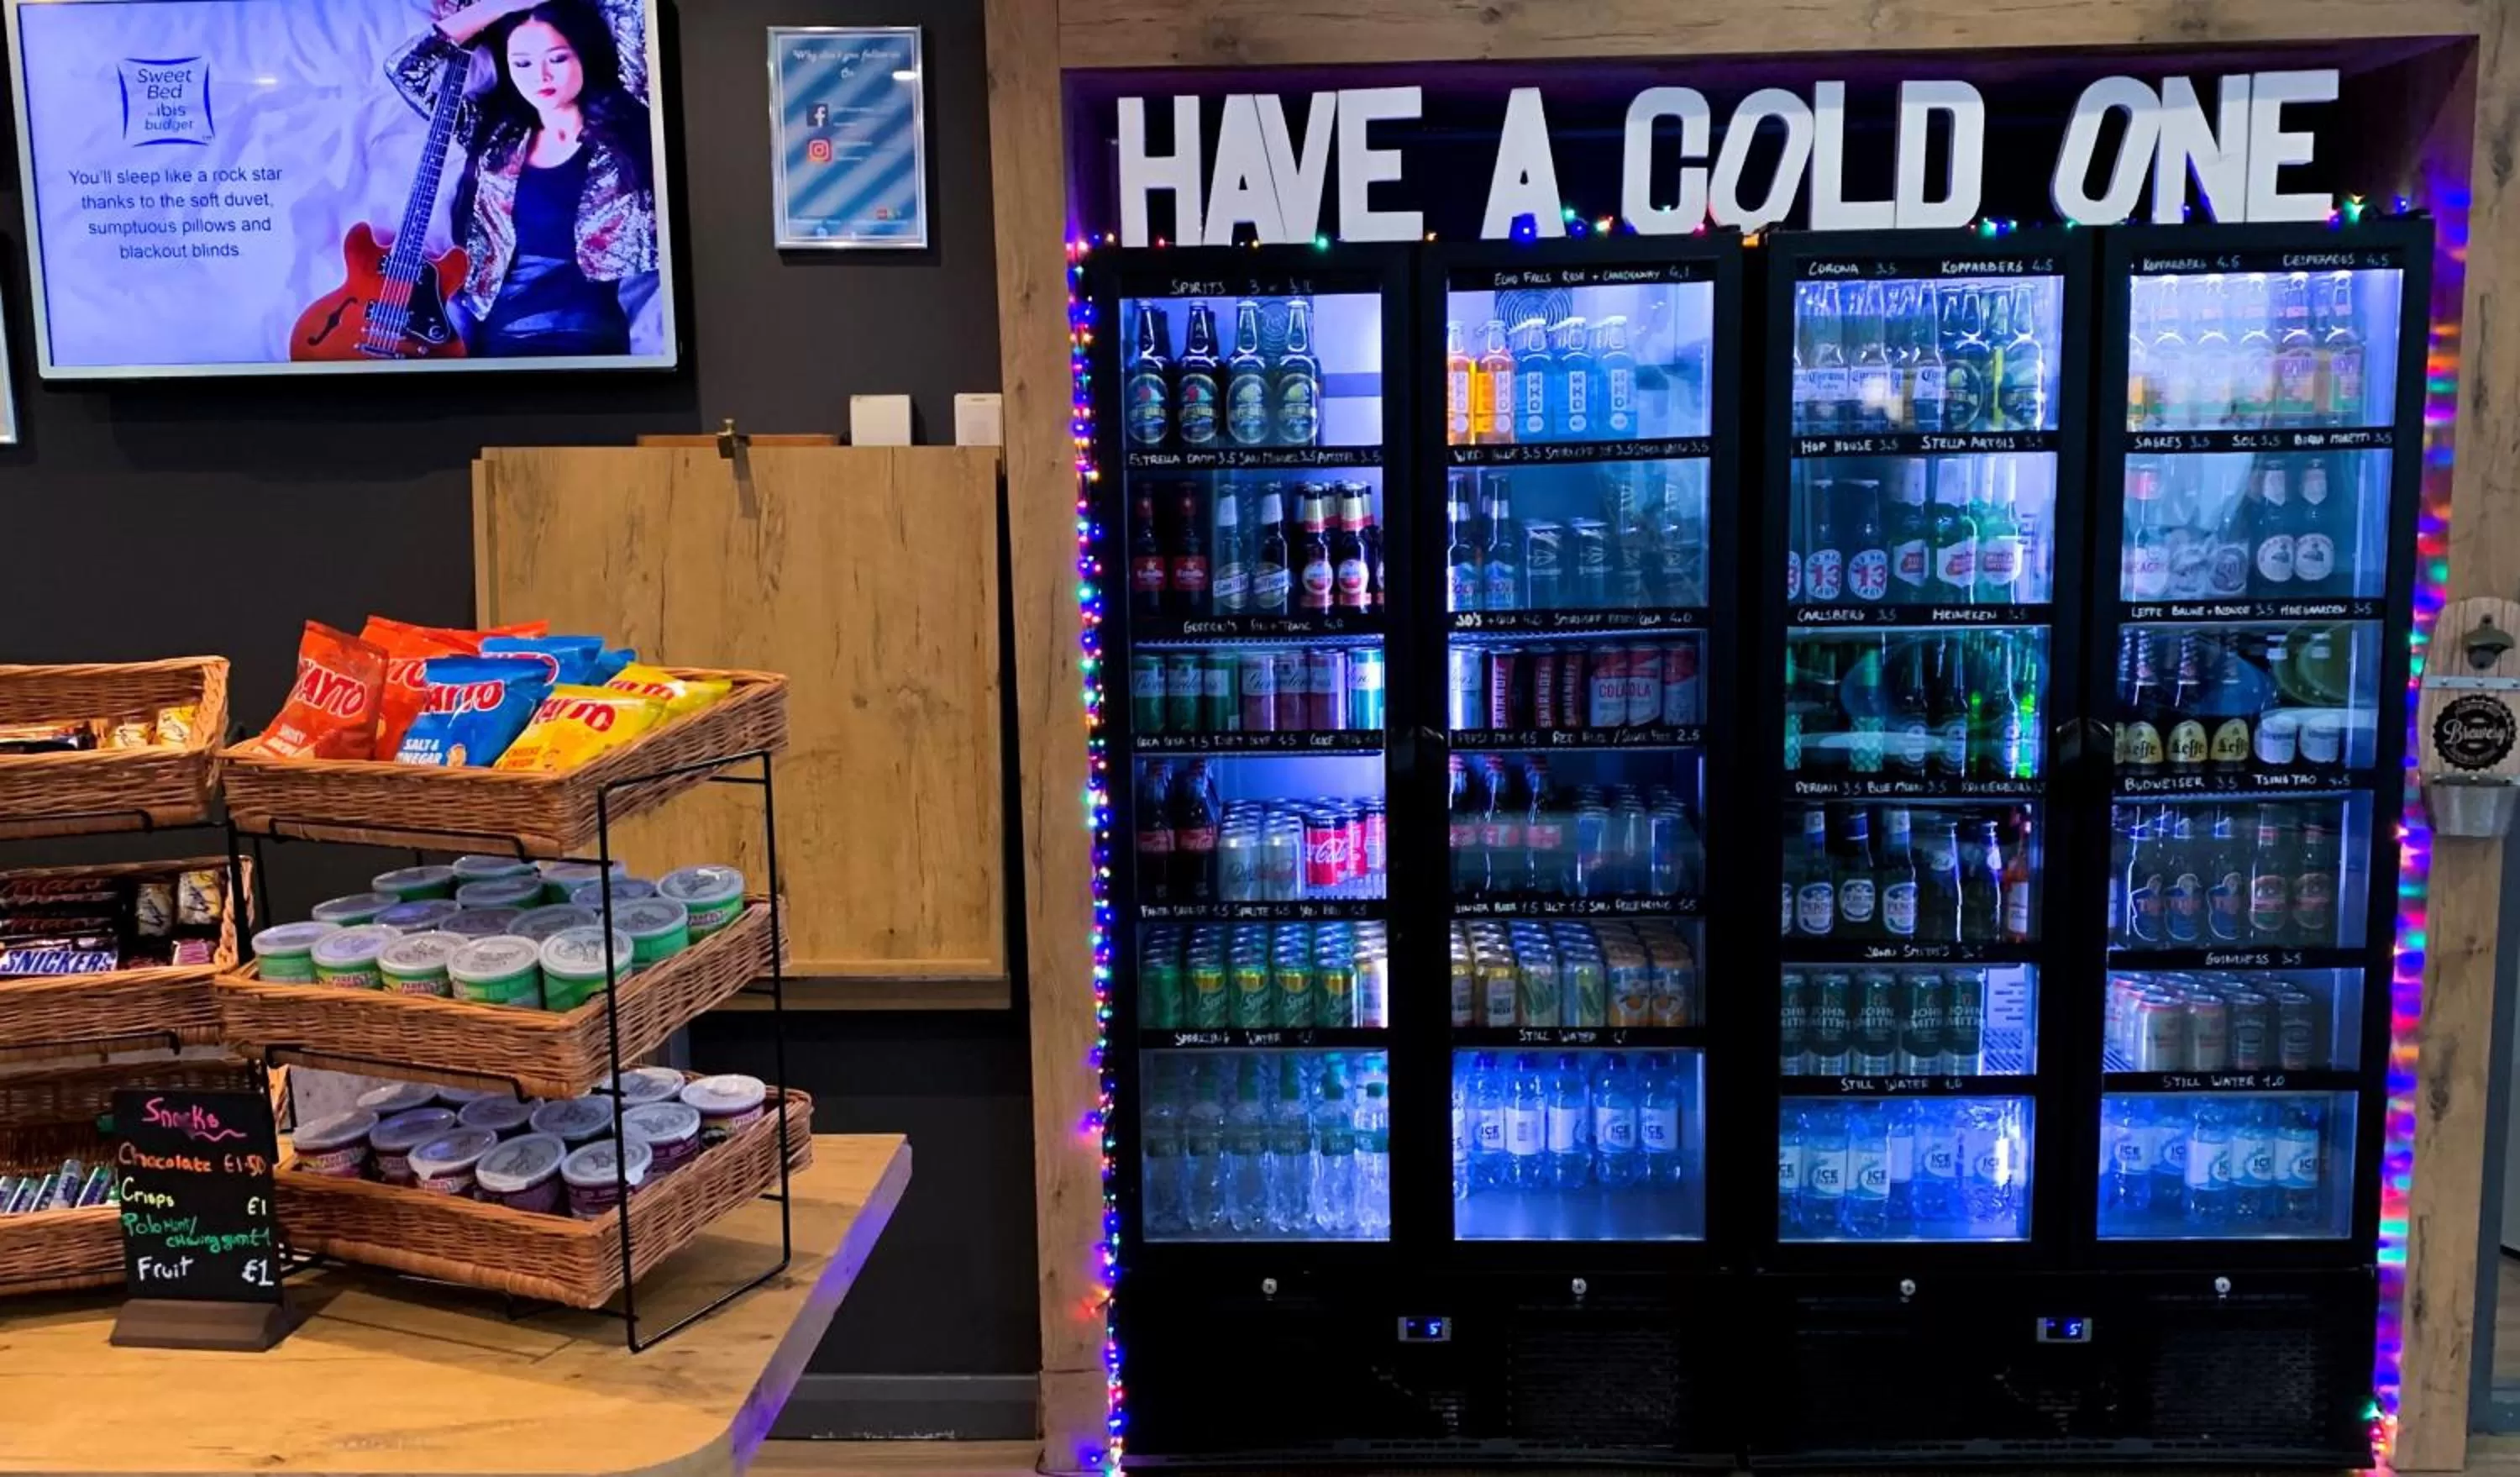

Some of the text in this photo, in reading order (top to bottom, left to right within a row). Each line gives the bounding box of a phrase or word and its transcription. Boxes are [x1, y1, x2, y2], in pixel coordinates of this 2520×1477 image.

[137, 68, 192, 83] Sweet
[147, 84, 182, 100] Bed
[156, 104, 186, 117] ibis
[144, 118, 195, 132] budget
[1117, 69, 2339, 248] HAVE A COLD ONE
[68, 167, 282, 186] You'll sleep like a rock star
[81, 192, 274, 210] thanks to the soft duvet,
[88, 217, 271, 238] sumptuous pillows and
[120, 244, 187, 260] blackout
[1808, 261, 1860, 276] CORONA
[1940, 259, 2024, 274] KOPPARBERG
[1169, 278, 1226, 295] SPIRITS
[1801, 439, 1828, 454] HOP
[1920, 434, 1966, 449] STELLA
[1970, 434, 2016, 449] ARTOIS
[2134, 434, 2182, 449] SAGRES
[2232, 434, 2258, 447] SOL
[1807, 564, 1842, 588] 13
[1852, 564, 1887, 588] 13
[422, 681, 506, 712] AYTO
[403, 738, 431, 751] SALT
[2124, 776, 2206, 792] BUDWEISER
[4, 949, 116, 972] SNICKERS
[1840, 1077, 1876, 1092] STILL
[2162, 1075, 2202, 1088] STILL
[2211, 1075, 2256, 1088] WATER
[118, 1141, 213, 1173] Chocolate
[121, 1177, 176, 1209] Crisps
[123, 1212, 163, 1238] Polo
[137, 1256, 276, 1287] Fruit £1
